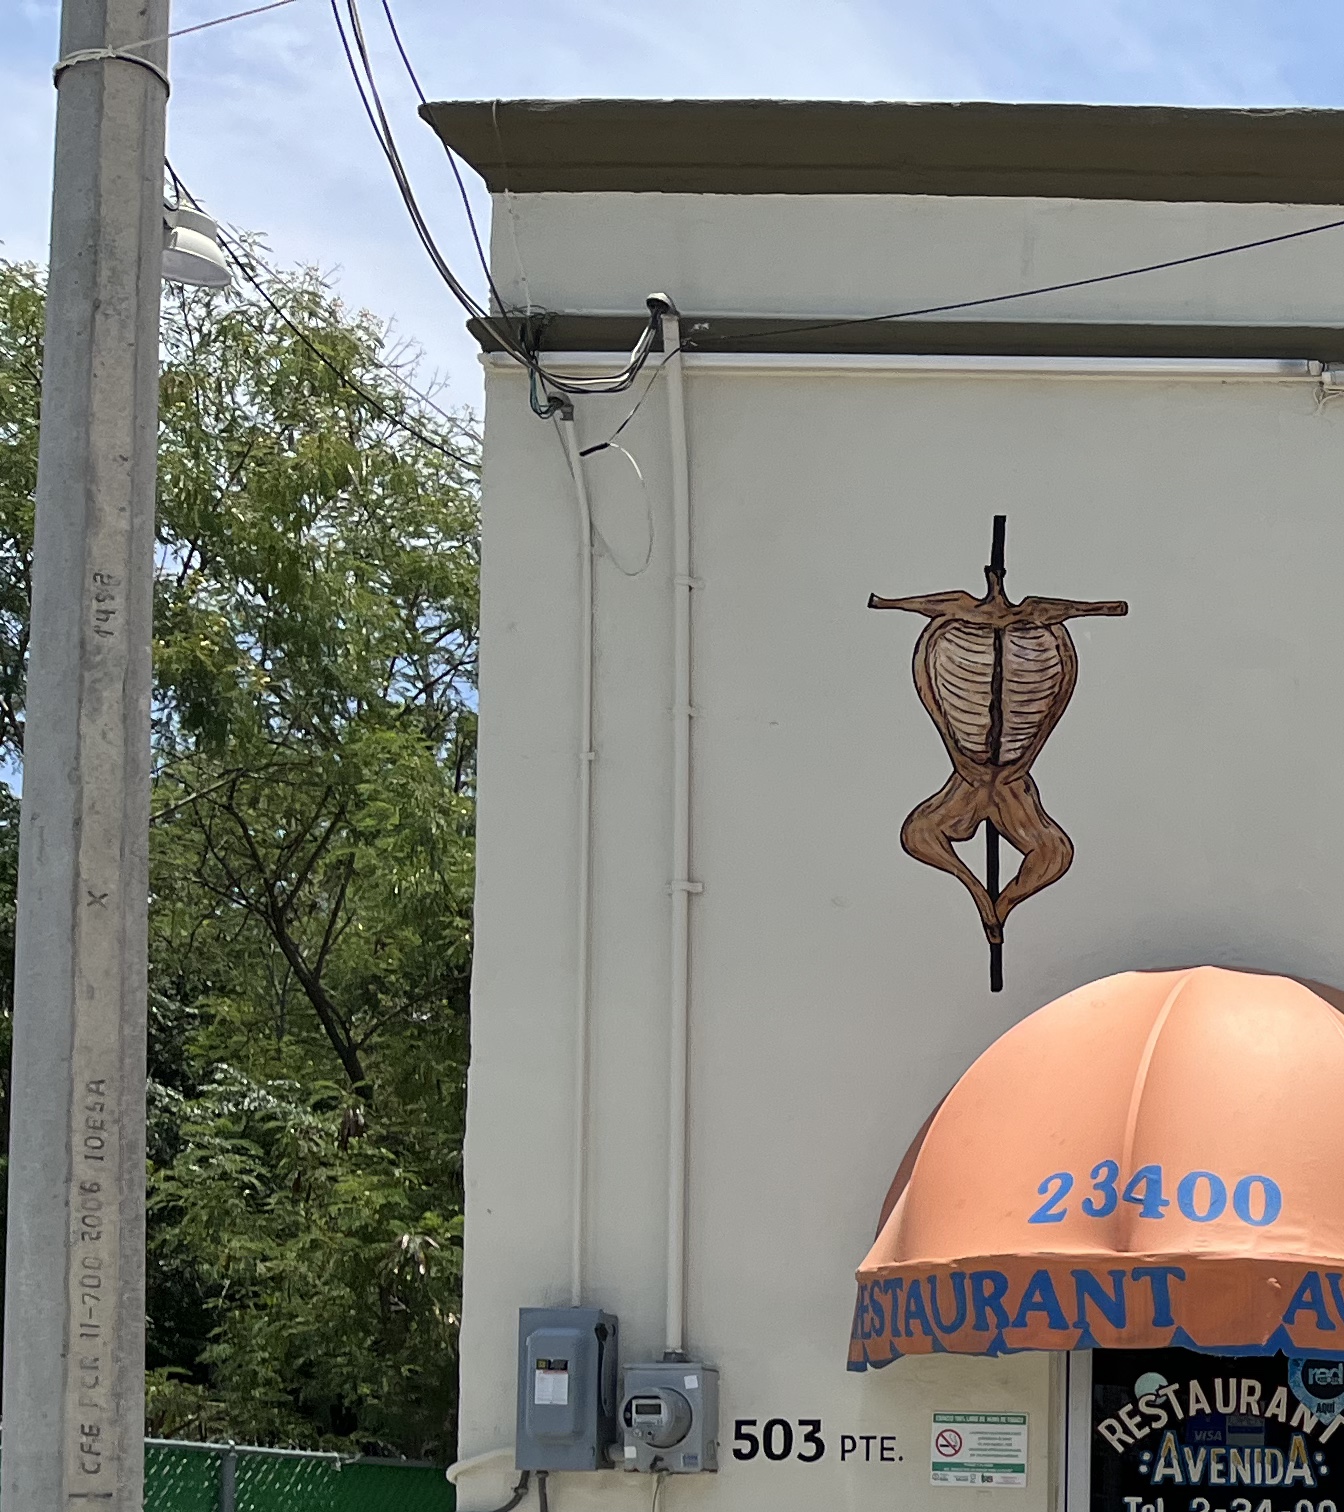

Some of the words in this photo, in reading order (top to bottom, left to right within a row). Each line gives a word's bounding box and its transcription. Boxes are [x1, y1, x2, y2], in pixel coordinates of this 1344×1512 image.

[1028, 1160, 1282, 1227] 23400
[732, 1418, 825, 1463] 503
[839, 1434, 904, 1462] PTE.
[1151, 1430, 1316, 1487] AVENIDA
